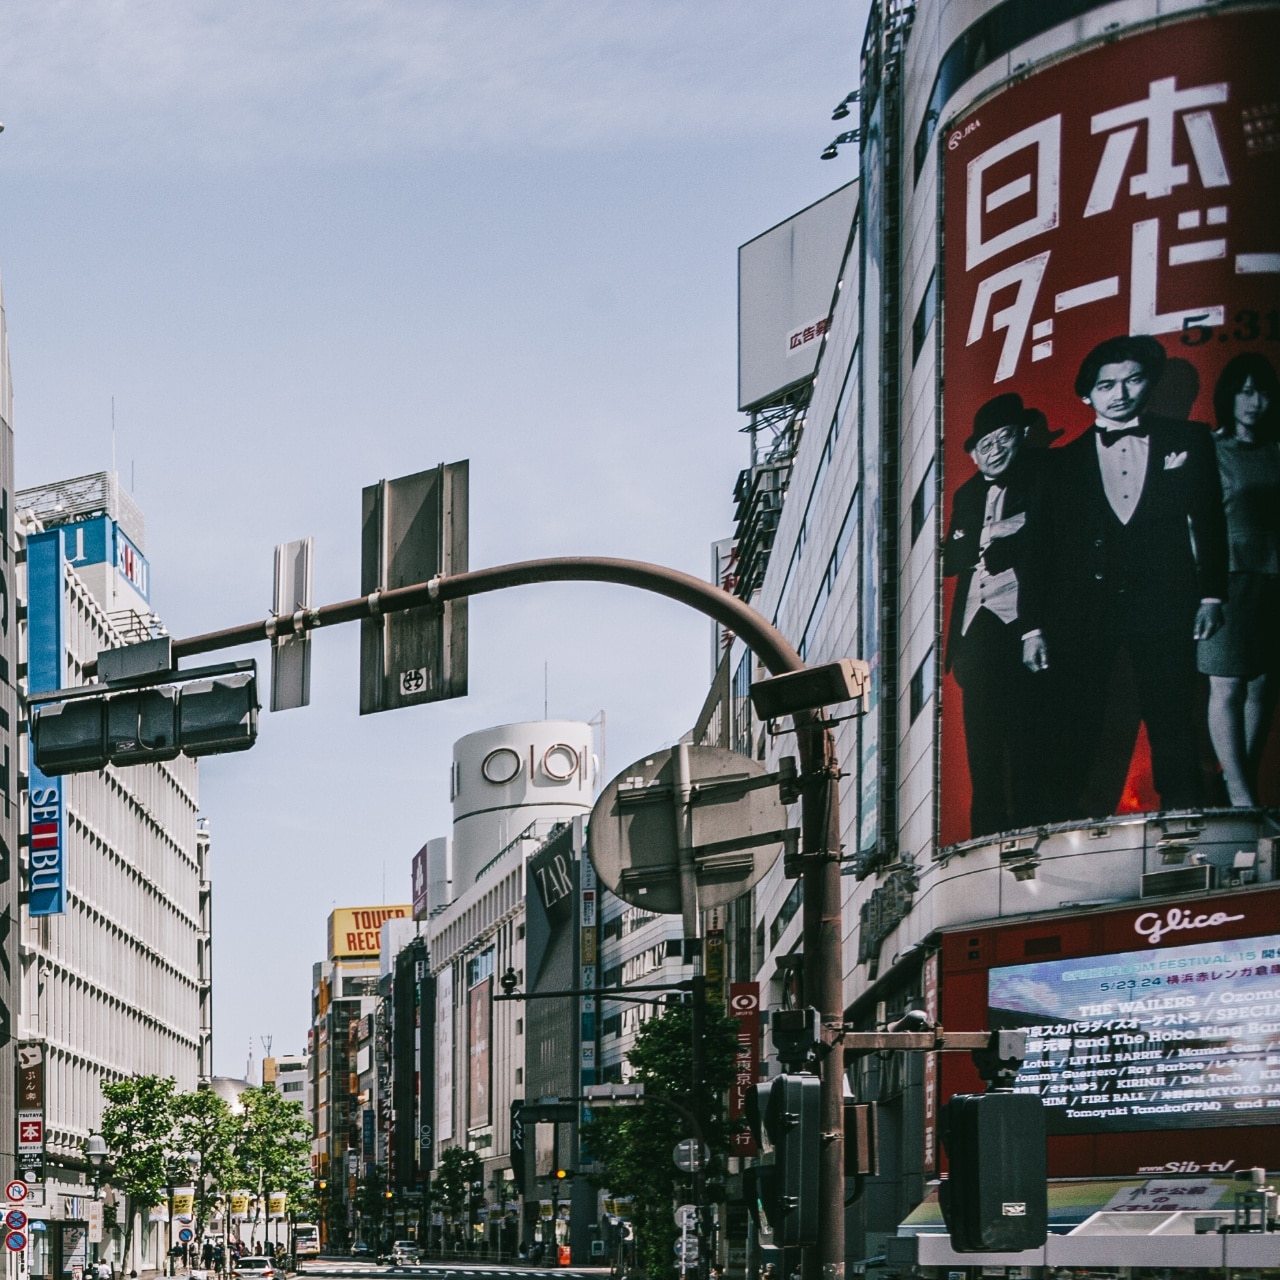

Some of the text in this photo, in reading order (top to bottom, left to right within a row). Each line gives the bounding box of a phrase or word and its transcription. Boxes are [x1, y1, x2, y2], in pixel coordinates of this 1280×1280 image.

[967, 76, 1230, 271] 日本
[31, 787, 59, 892] SEIBU
[537, 851, 574, 909] ZAR
[1134, 908, 1245, 944] Glico
[1159, 954, 1232, 970] FESTIVAL
[1142, 976, 1162, 987] 24
[1079, 995, 1196, 1017] THE WAILERS
[1075, 1036, 1109, 1048] and
[1113, 1032, 1145, 1046] The
[1149, 1029, 1192, 1044] Hobo
[1199, 1024, 1243, 1040] King
[1070, 1053, 1113, 1066] LITTLE
[1115, 1049, 1163, 1062] BARRIE
[1061, 1066, 1117, 1080] Guerrero
[1117, 1077, 1166, 1089] KIRINJI
[1081, 1093, 1109, 1104] FIRE
[1112, 1090, 1146, 1102] BALL
[1066, 1106, 1128, 1118] Tomoyuki
[1234, 1098, 1262, 1109] and
[23, 1123, 39, 1141] 本
